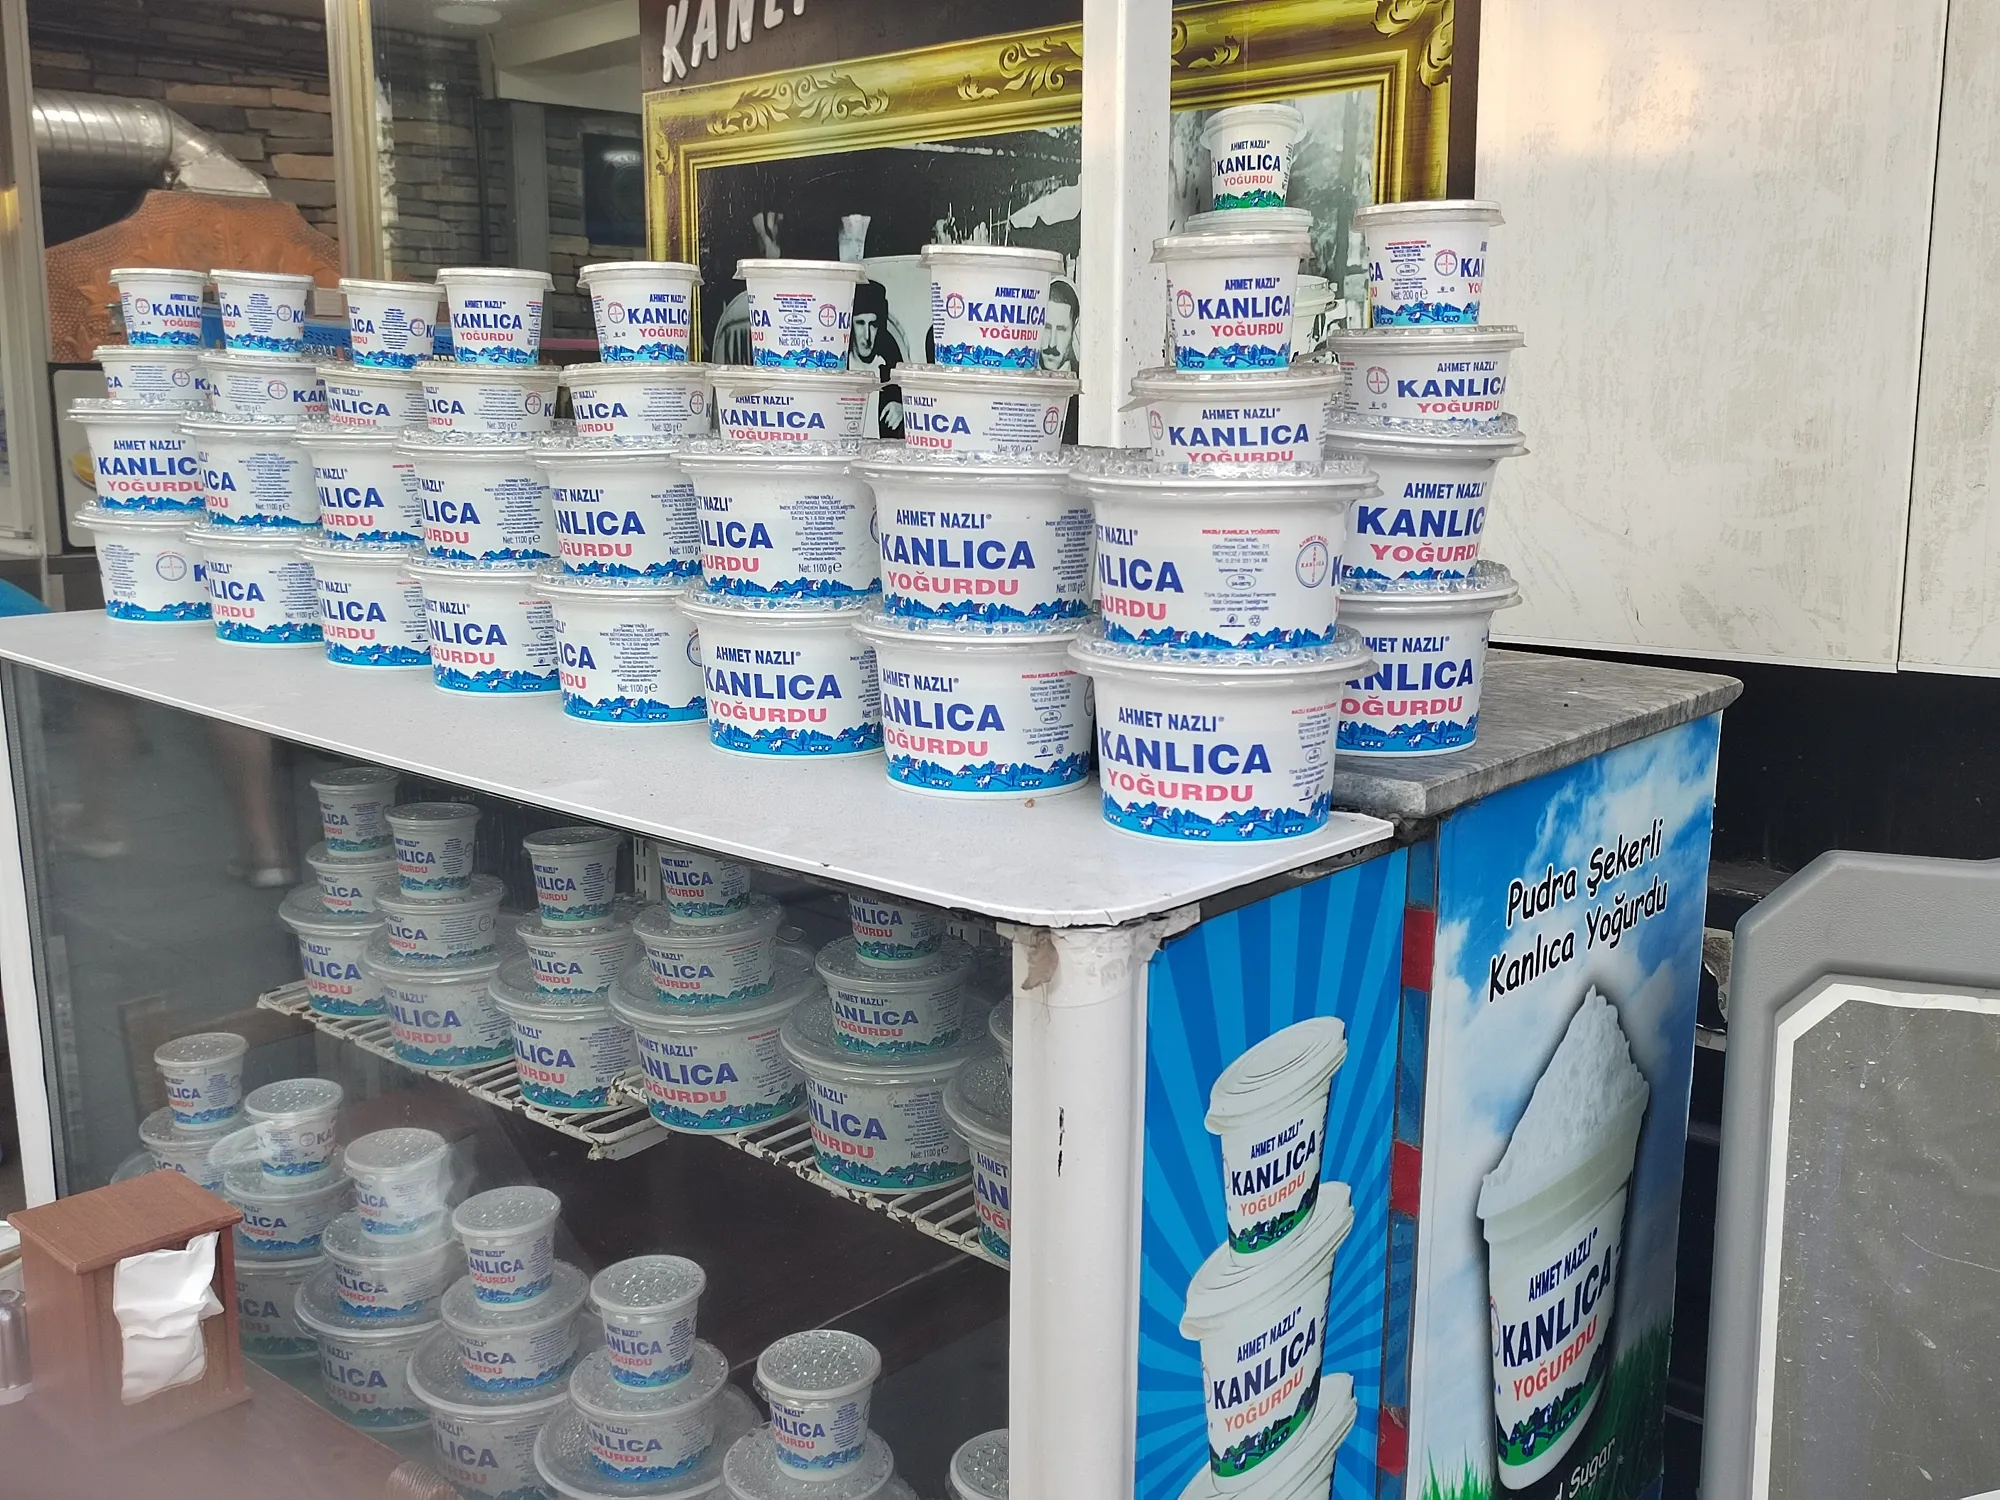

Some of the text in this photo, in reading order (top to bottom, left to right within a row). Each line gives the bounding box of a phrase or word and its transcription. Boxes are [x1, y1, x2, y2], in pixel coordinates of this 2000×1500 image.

[1231, 141, 1248, 151] AHMET
[1217, 154, 1281, 176] KANLICA
[1224, 174, 1273, 186] YOĞURDU
[995, 287, 1020, 298] AHMET
[1225, 279, 1253, 291] AHMET
[650, 295, 669, 303] AHMET
[1198, 295, 1291, 319] KANLICA
[453, 313, 522, 329] KANLICA
[968, 302, 1046, 325] KANLICA
[460, 330, 514, 341] YOĞURDU
[979, 326, 1038, 341] YOĞURDU
[1211, 321, 1284, 337] YOĞURDU
[1437, 363, 1471, 372] AHMET
[427, 399, 465, 414] LICA
[736, 397, 761, 405] AHMET
[1417, 400, 1499, 413] YOĞURDU
[720, 409, 825, 429] KANLICA
[904, 413, 971, 434] NLICA
[1202, 409, 1239, 420] AHMET
[729, 429, 808, 440] YOĞURDU
[1168, 424, 1309, 446] KANLICA
[114, 441, 146, 450] AHMET
[1187, 450, 1294, 461] YOĞURDU
[98, 456, 201, 476] KANLIC
[1404, 483, 1453, 499] AHMET
[421, 498, 481, 524] LICA
[897, 509, 935, 527] AHMET
[1357, 506, 1485, 537] KANLIC
[425, 527, 470, 543] URDU
[881, 532, 1035, 570] KANLICA
[888, 571, 1019, 595] YOĞURDU
[429, 619, 507, 645] NLICA
[716, 646, 751, 663] AHMET
[1362, 637, 1398, 653] MET
[704, 665, 842, 700] KANLICA
[883, 669, 910, 687] AHMET
[710, 699, 827, 723] YOĞURDU
[883, 694, 1005, 731] ANLICA
[1341, 695, 1463, 716] OĞURDU
[1119, 707, 1162, 729] AHMET
[1100, 727, 1272, 774] KANLICA
[1107, 768, 1253, 802] YOĞURDU
[323, 813, 349, 826] LICA
[1507, 819, 1664, 927] Pudra Şekerli
[1490, 876, 1667, 1002] Kanlıca Yoğurdu
[303, 959, 361, 980] NLICA
[532, 957, 583, 975] NLICA
[390, 1005, 462, 1028] NLICA
[830, 1002, 919, 1025] ANLICA
[641, 1052, 739, 1085] ANLICA
[645, 1078, 727, 1104] OĞURDU
[809, 1096, 887, 1140] NLICA
[1251, 1137, 1275, 1159] AHMET
[1232, 1130, 1316, 1196] KANLICA
[1241, 1171, 1306, 1217] YOĞURDU
[243, 1215, 287, 1228] LICA
[470, 1259, 524, 1274] ANLICA
[1529, 1264, 1562, 1302] AHMET
[1502, 1245, 1611, 1368] KANLICA
[1237, 1332, 1268, 1363] AHMET
[1513, 1314, 1598, 1401] YOĞURDU
[1214, 1318, 1316, 1410] KANLICA
[1224, 1366, 1304, 1432] YOĞURDU
[1569, 1438, 1616, 1499] Sugar
